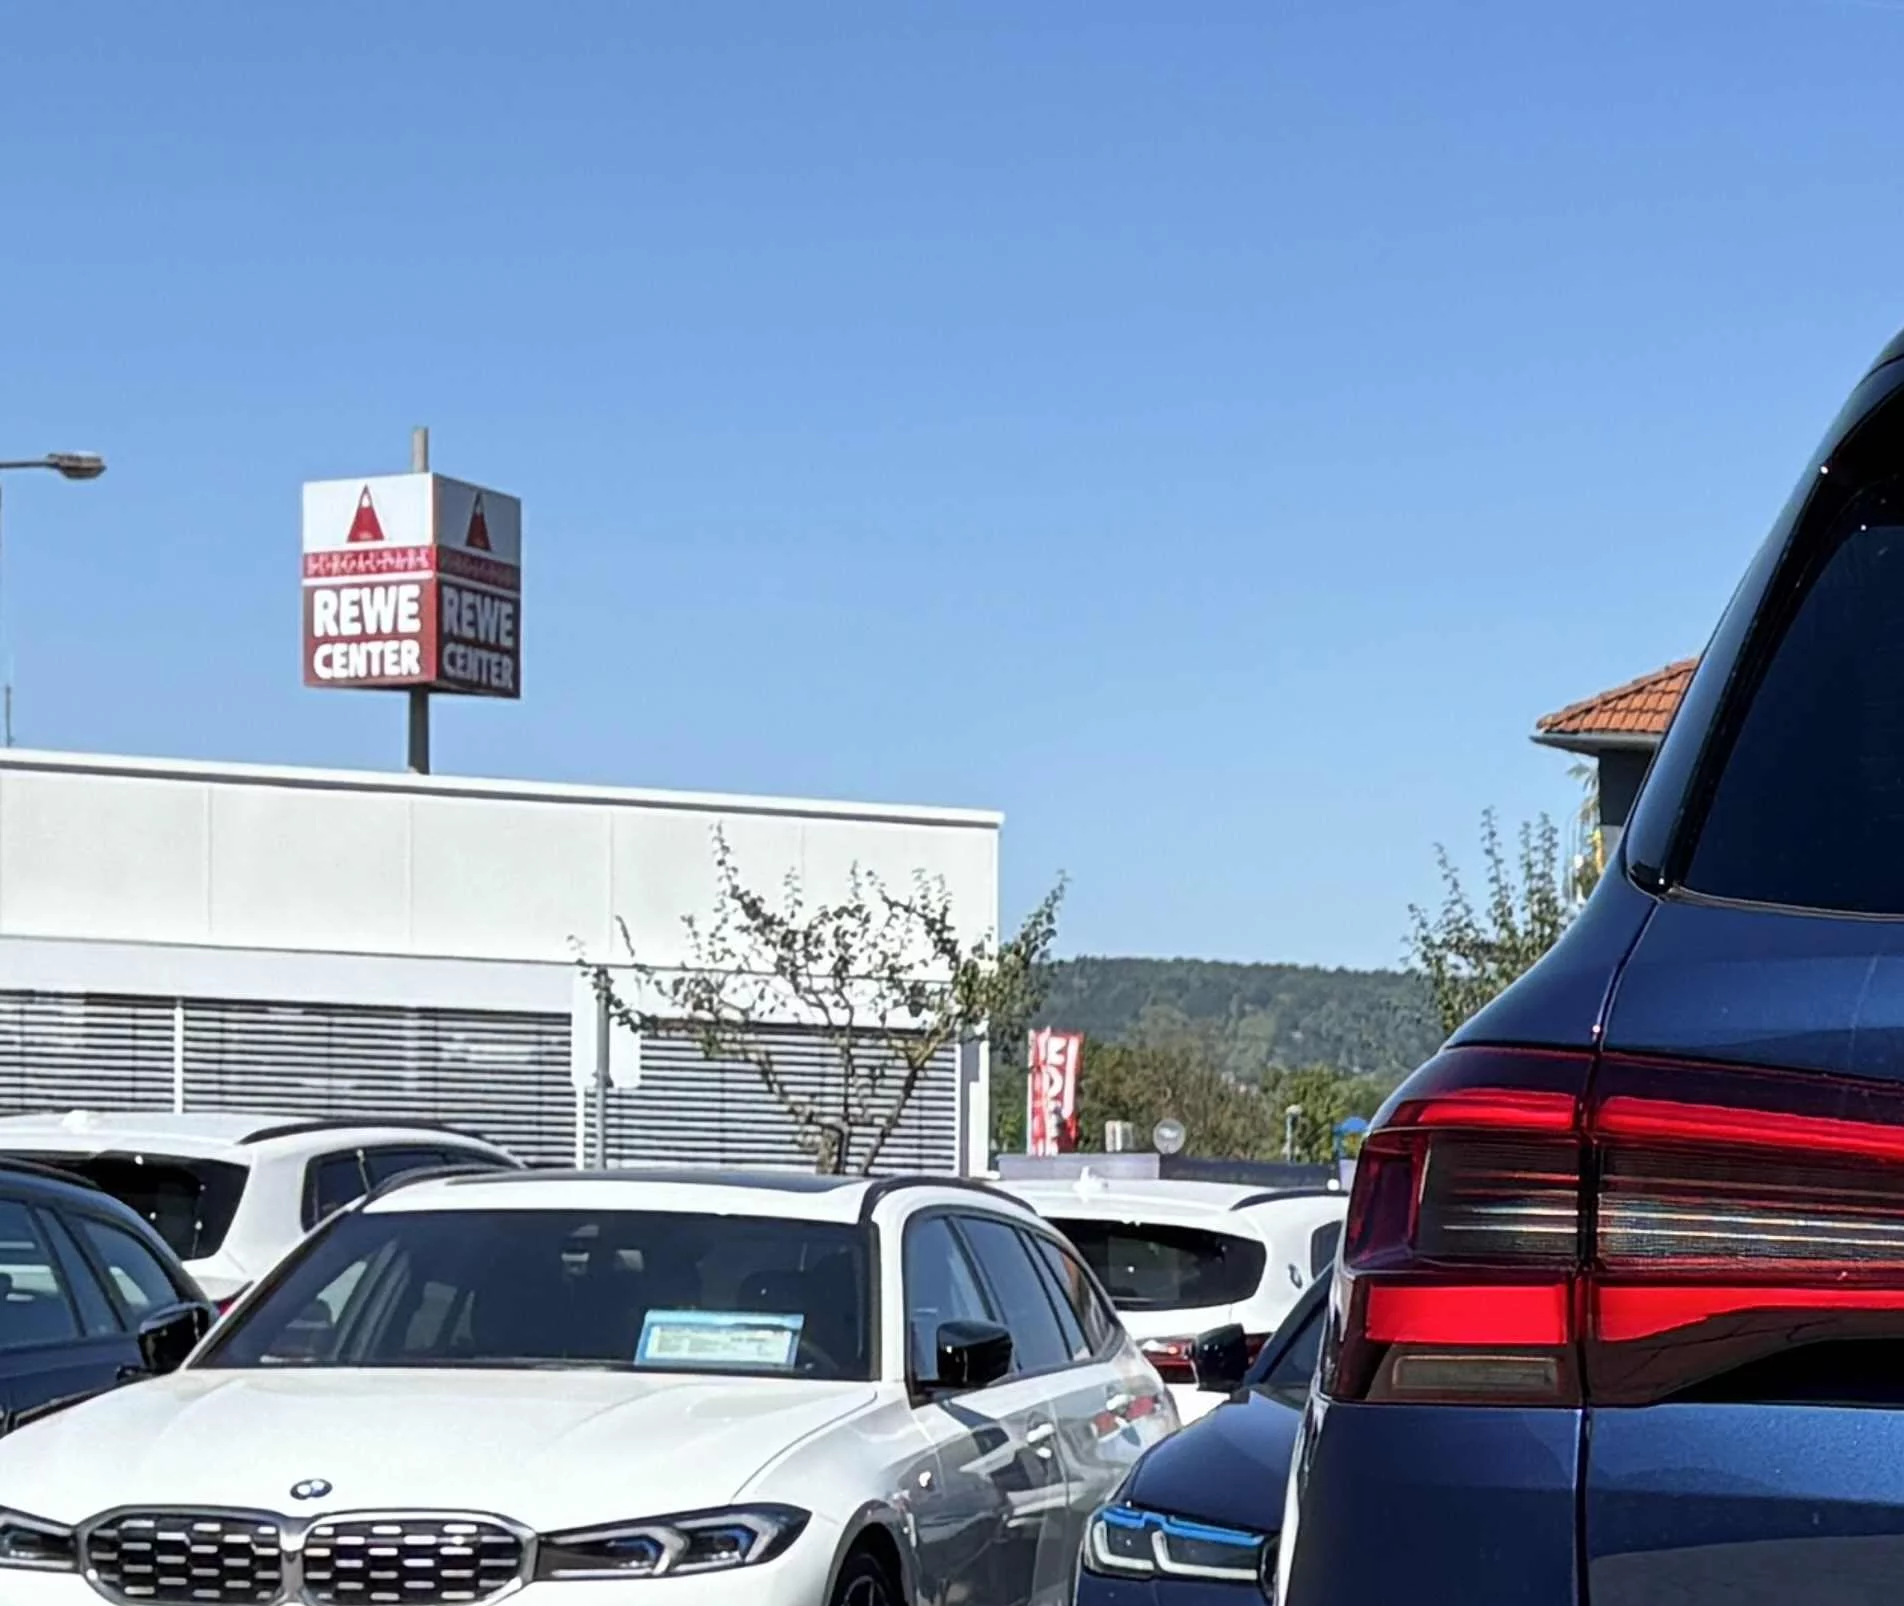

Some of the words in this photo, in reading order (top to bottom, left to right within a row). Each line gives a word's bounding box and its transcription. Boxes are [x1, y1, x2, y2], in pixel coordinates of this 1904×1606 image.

[313, 584, 420, 637] REWE
[441, 585, 514, 647] REWE
[313, 640, 420, 679] CENTER
[442, 642, 514, 690] CENTER
